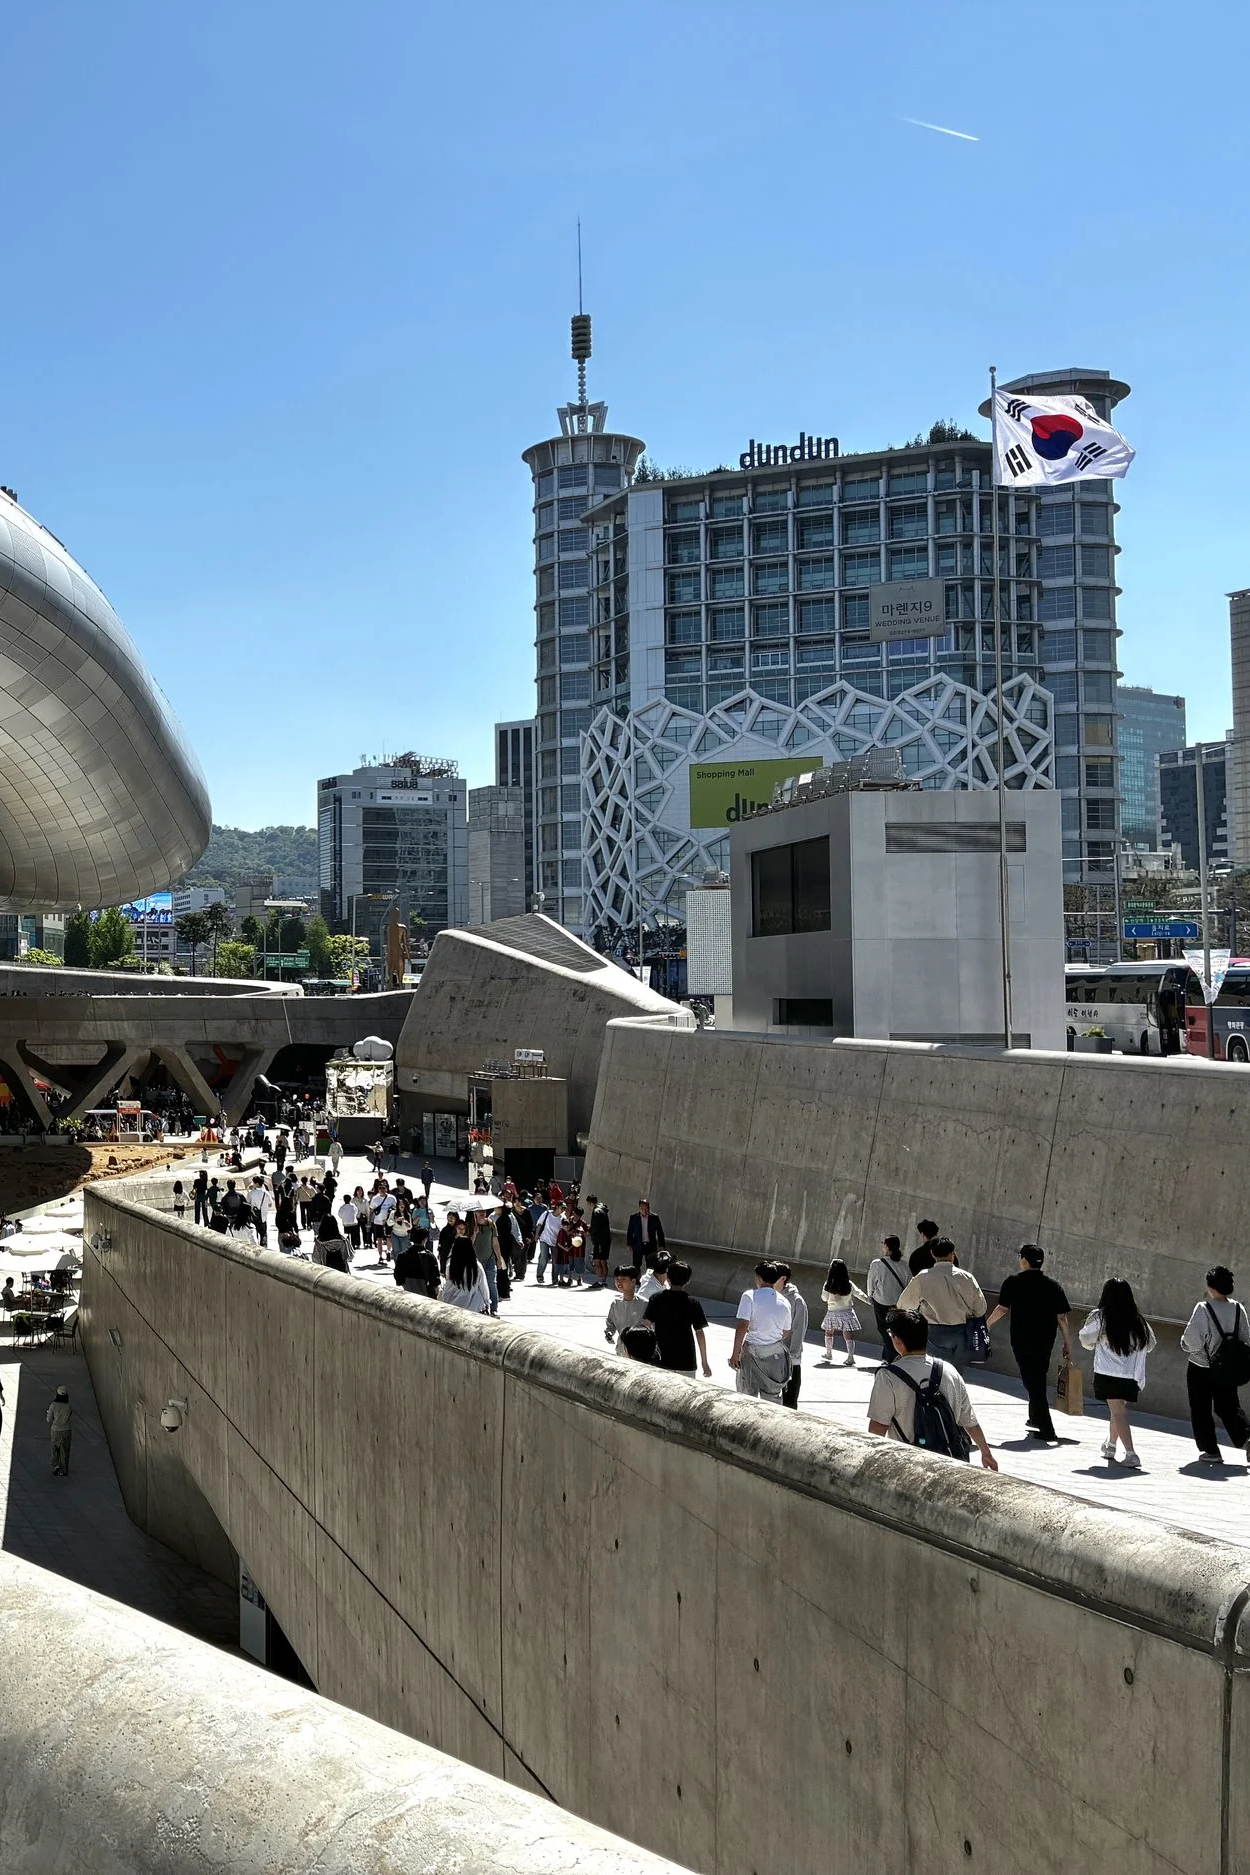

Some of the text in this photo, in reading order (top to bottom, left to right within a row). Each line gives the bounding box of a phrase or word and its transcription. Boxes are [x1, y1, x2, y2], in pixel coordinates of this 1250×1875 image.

[739, 431, 839, 469] dundun
[881, 601, 932, 616] 마렌지9
[874, 615, 941, 627] WEDDING VENUE
[696, 768, 755, 779] Shopping Mall
